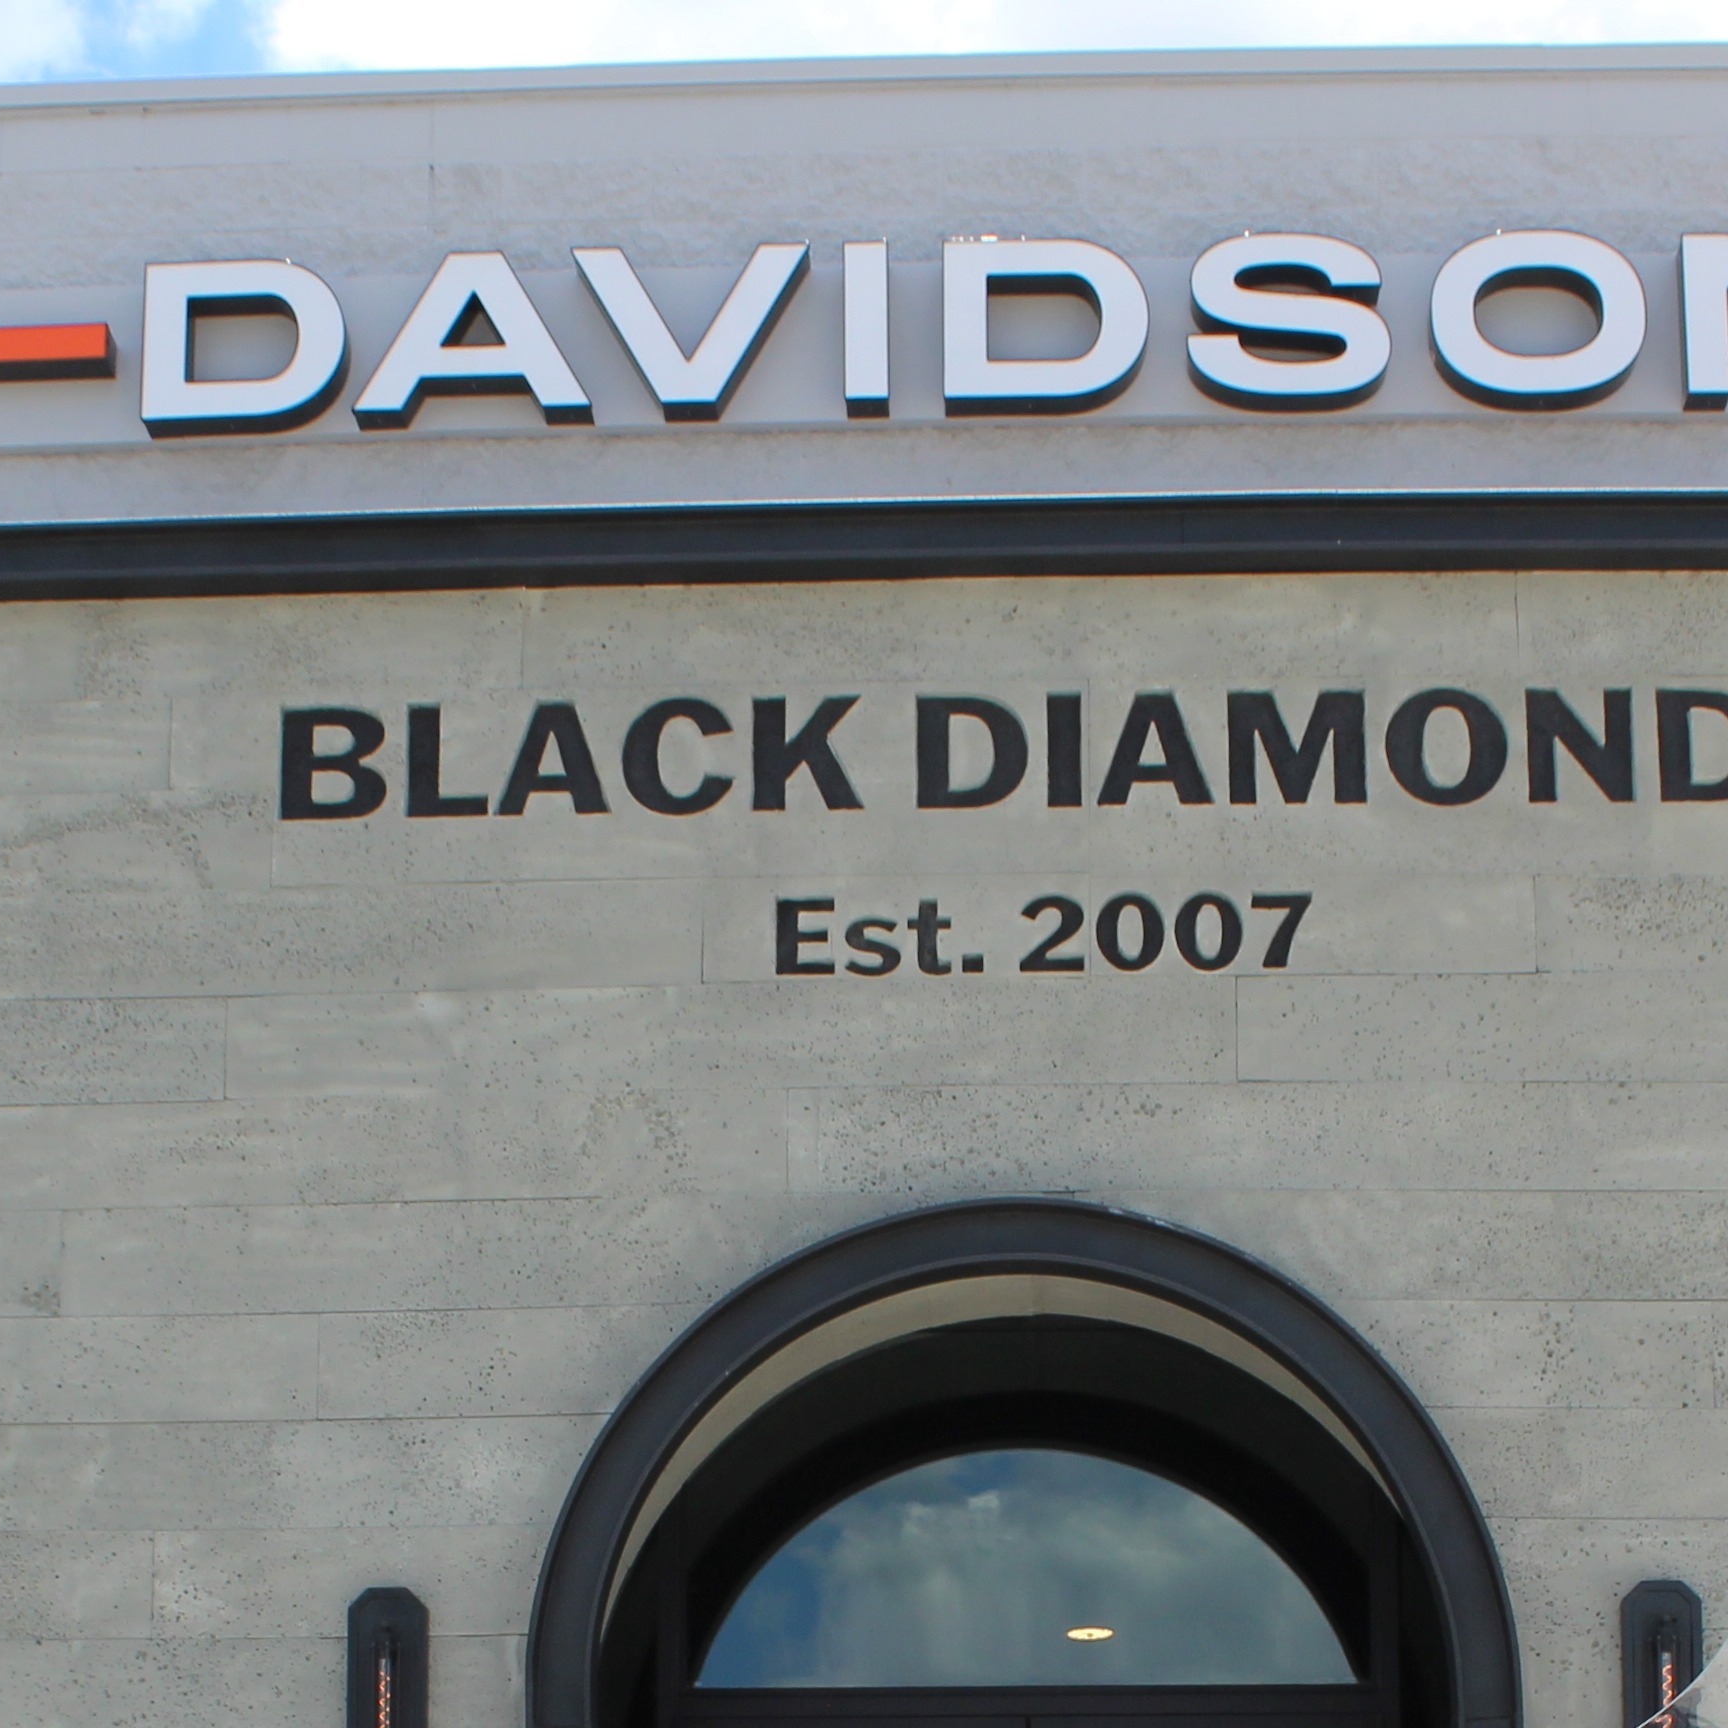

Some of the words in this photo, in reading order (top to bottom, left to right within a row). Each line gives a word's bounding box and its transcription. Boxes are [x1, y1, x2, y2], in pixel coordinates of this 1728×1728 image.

[278, 692, 867, 822] BLACK
[772, 894, 984, 977] Est.
[1017, 892, 1314, 974] 2007
